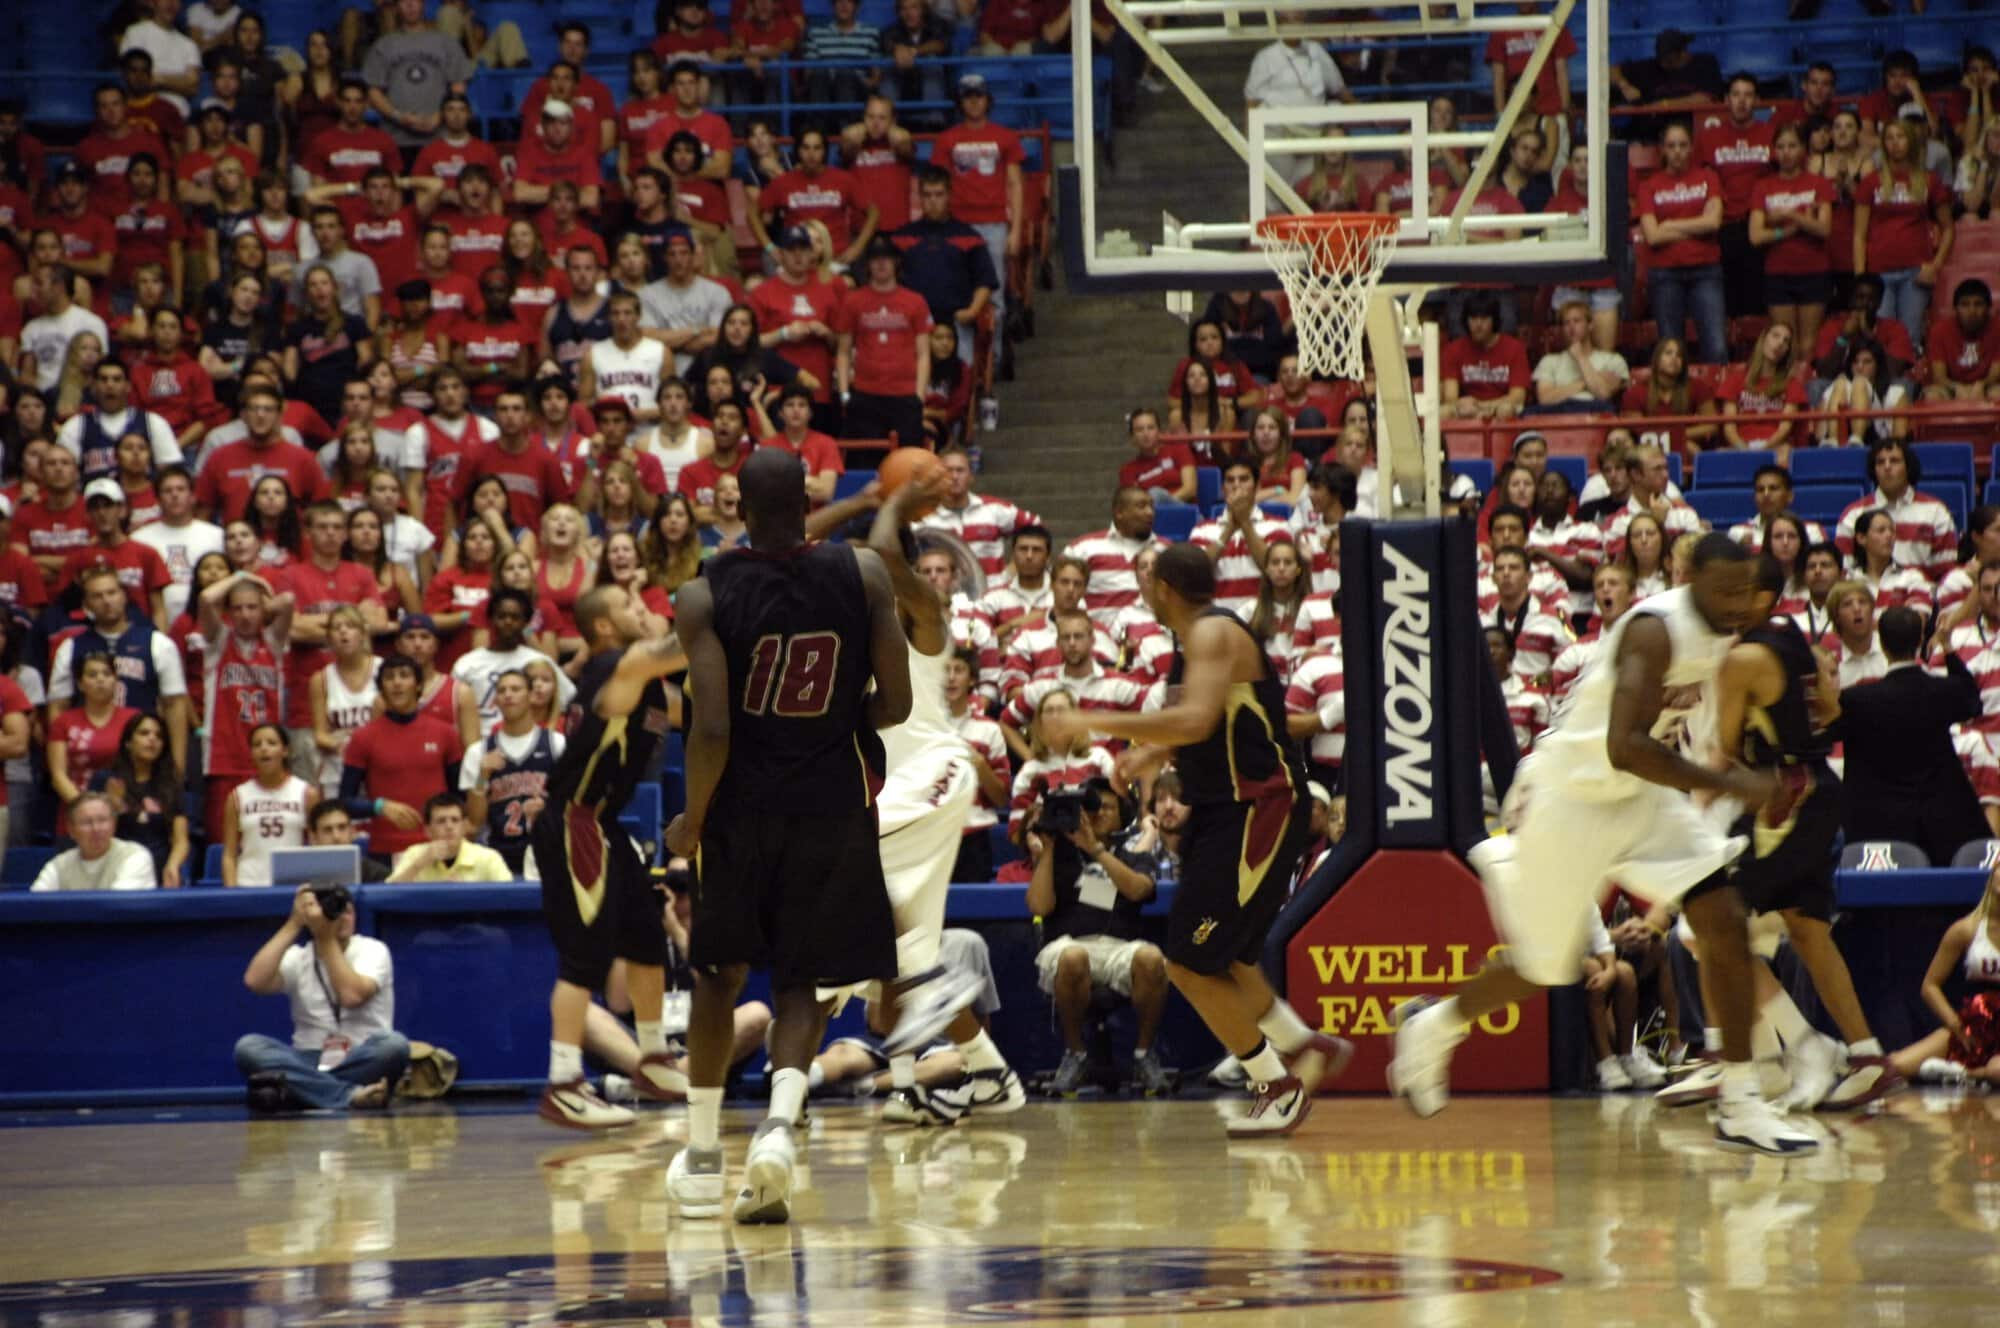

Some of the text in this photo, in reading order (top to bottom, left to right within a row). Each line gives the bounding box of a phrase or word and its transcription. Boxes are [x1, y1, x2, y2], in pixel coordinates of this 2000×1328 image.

[1382, 541, 1433, 821] ARIZONA
[244, 801, 300, 815] ARIZONA
[260, 815, 284, 838] 55
[1317, 995, 1521, 1036] FAO
